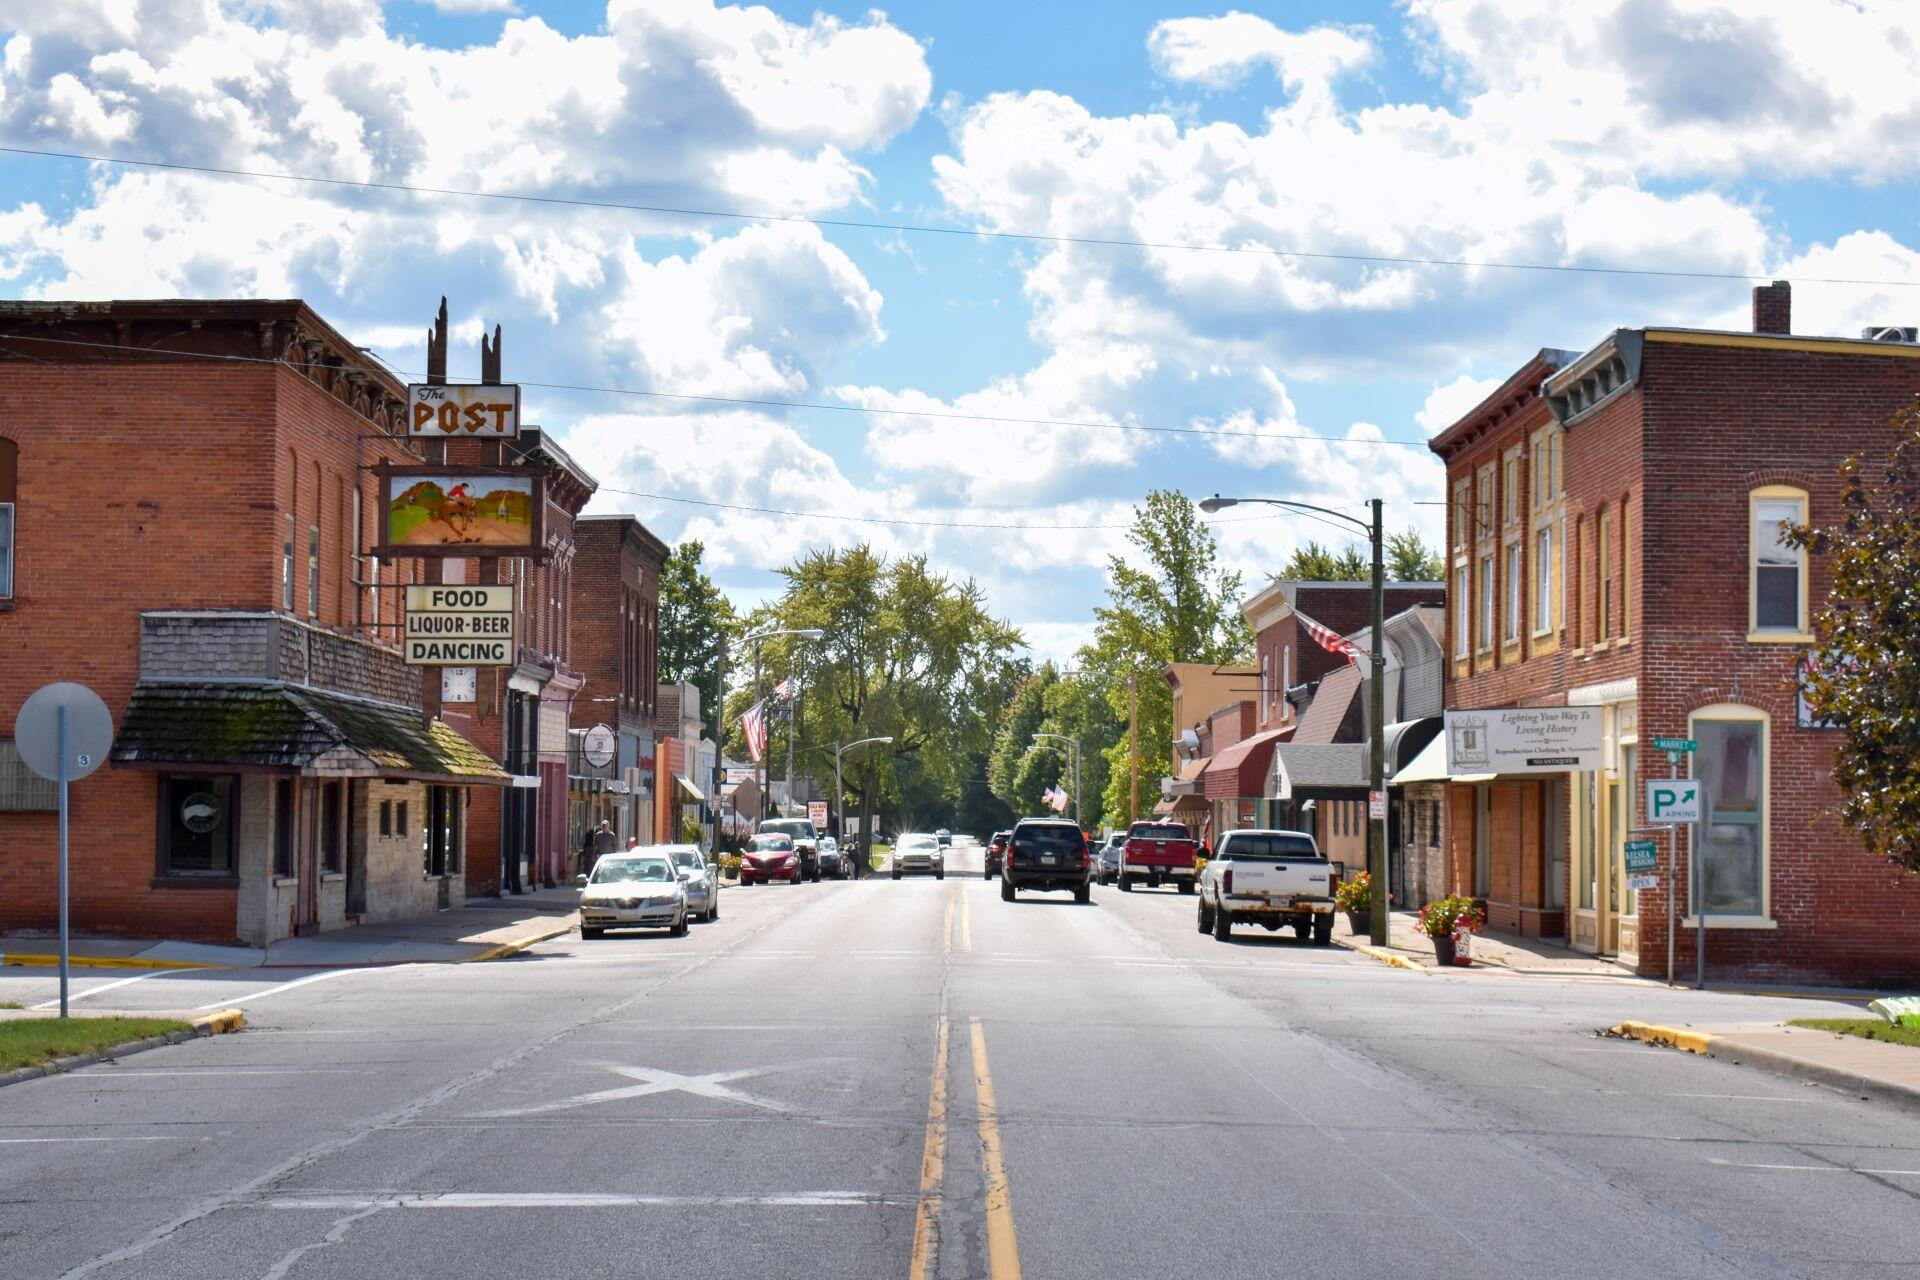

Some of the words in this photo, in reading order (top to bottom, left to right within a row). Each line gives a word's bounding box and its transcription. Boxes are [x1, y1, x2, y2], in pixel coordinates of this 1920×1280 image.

[418, 387, 446, 400] The
[414, 400, 513, 433] POST
[432, 590, 488, 607] FOOD
[409, 616, 510, 633] LIQUOR-BEER
[413, 642, 505, 660] DANCING
[1502, 713, 1539, 725] Lighting
[1539, 712, 1559, 722] Your
[1561, 711, 1578, 723] Way
[1580, 711, 1591, 720] To
[1515, 725, 1545, 736] Living
[1546, 724, 1577, 735] History
[1660, 739, 1689, 750] MARKET
[1495, 748, 1533, 756] Reproduction
[80, 755, 88, 765] 3
[1632, 879, 1650, 889] OPEN
